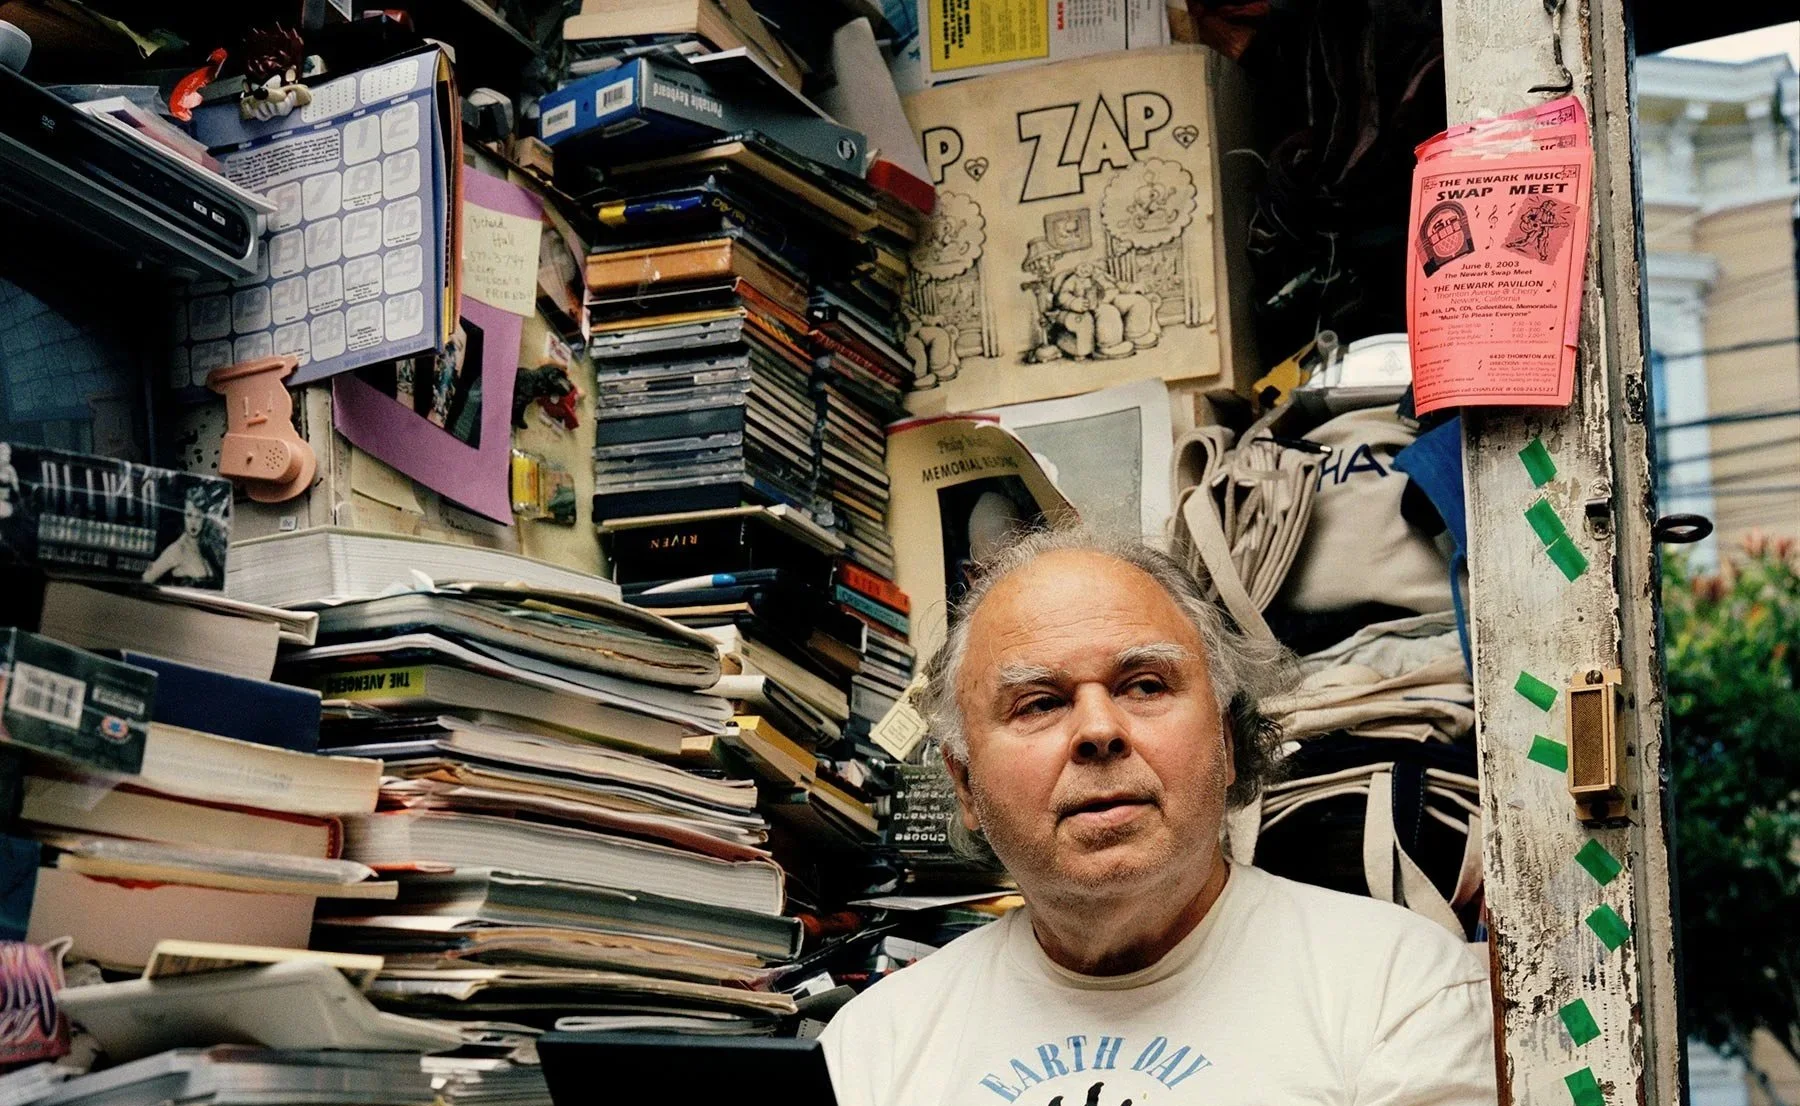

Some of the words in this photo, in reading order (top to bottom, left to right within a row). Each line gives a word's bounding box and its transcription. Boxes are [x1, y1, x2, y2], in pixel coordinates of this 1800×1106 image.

[653, 83, 690, 107] Keyboard
[1017, 91, 1173, 203] ZAP
[1439, 179, 1461, 188] THE
[1466, 174, 1519, 185] NEWARK
[1524, 171, 1562, 181] MUSIC
[1436, 186, 1494, 202] SWAP
[1509, 183, 1569, 195] MEET
[1460, 270, 1488, 278] Newark
[1491, 269, 1512, 277] Swap
[1433, 284, 1451, 293] THE
[1453, 281, 1495, 291] NEWARK
[1498, 280, 1544, 288] PAVILION
[1471, 311, 1493, 319] Please
[922, 458, 983, 483] MEMORIAL
[650, 534, 698, 549] RIVEN
[389, 672, 410, 688] THE
[894, 833, 947, 842] Choose
[979, 1034, 1126, 1104] EARTH
[1130, 1034, 1213, 1091] DAY
